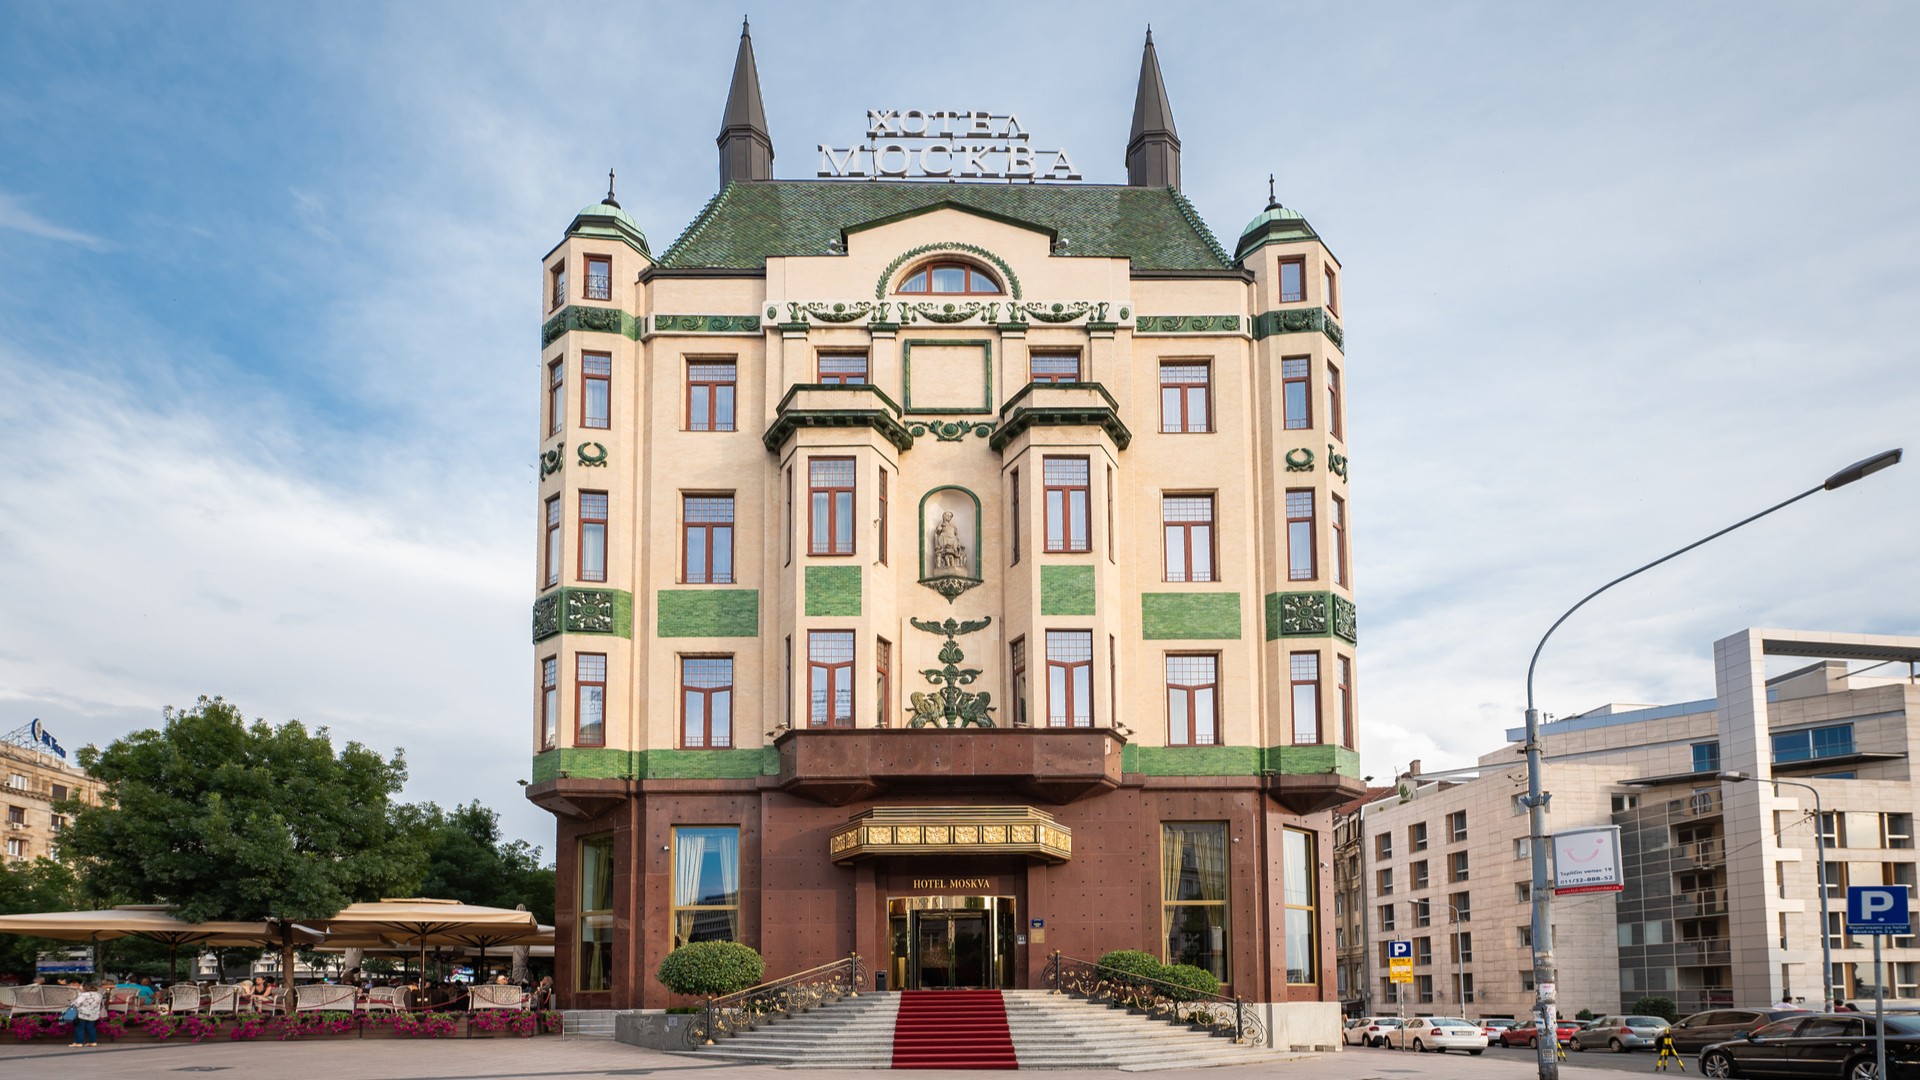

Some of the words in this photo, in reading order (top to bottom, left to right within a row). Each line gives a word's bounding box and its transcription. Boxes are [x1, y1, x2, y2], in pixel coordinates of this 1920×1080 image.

[866, 109, 1029, 138] ХОТЕЛ
[817, 144, 1082, 179] МОСКВА
[913, 879, 946, 889] HOTEL
[949, 879, 990, 889] MOSKVA
[1861, 891, 1894, 920] P
[1394, 943, 1407, 956] P
